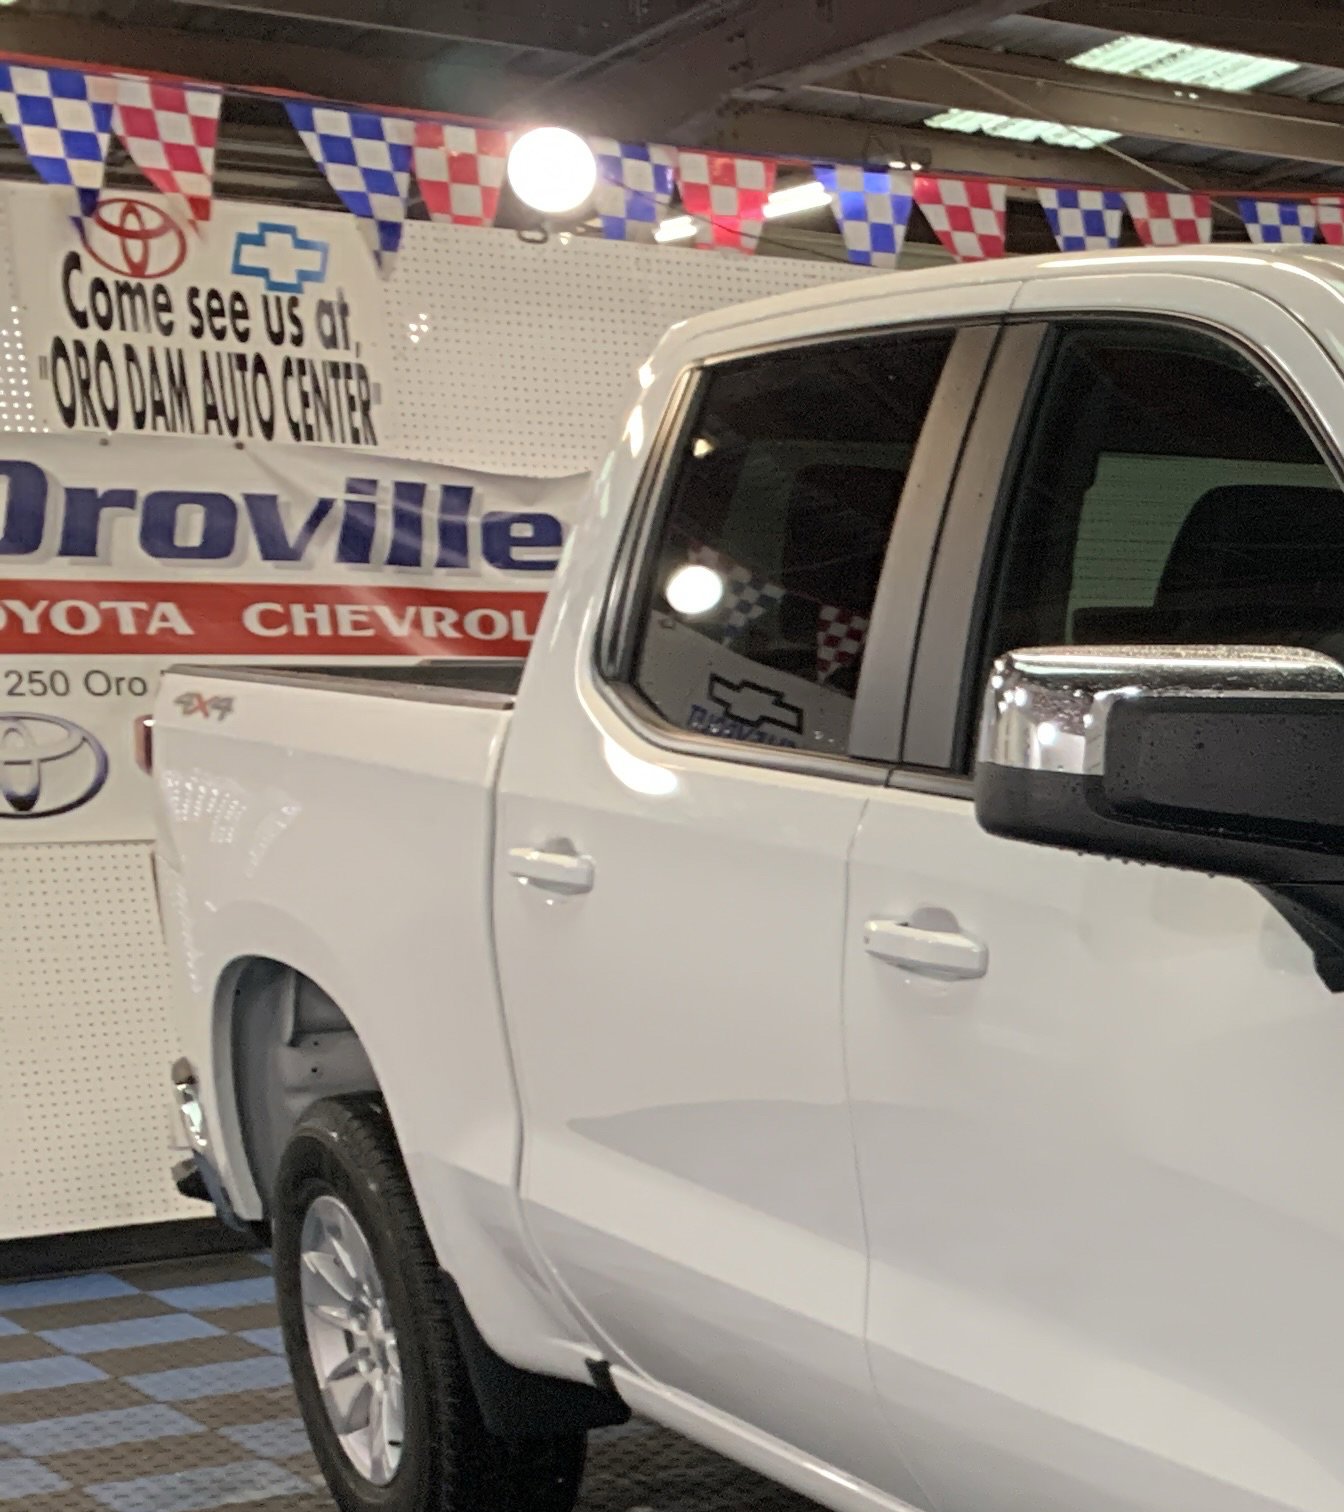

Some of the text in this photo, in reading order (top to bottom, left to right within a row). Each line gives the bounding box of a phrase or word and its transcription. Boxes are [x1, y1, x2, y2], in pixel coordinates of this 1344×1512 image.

[62, 251, 174, 337] Come
[186, 286, 251, 342] see
[261, 293, 304, 347] us
[124, 343, 195, 433] DAM
[201, 350, 275, 441] AUTO
[0, 599, 195, 636] YOTA
[4, 670, 148, 697] 250 Oro
